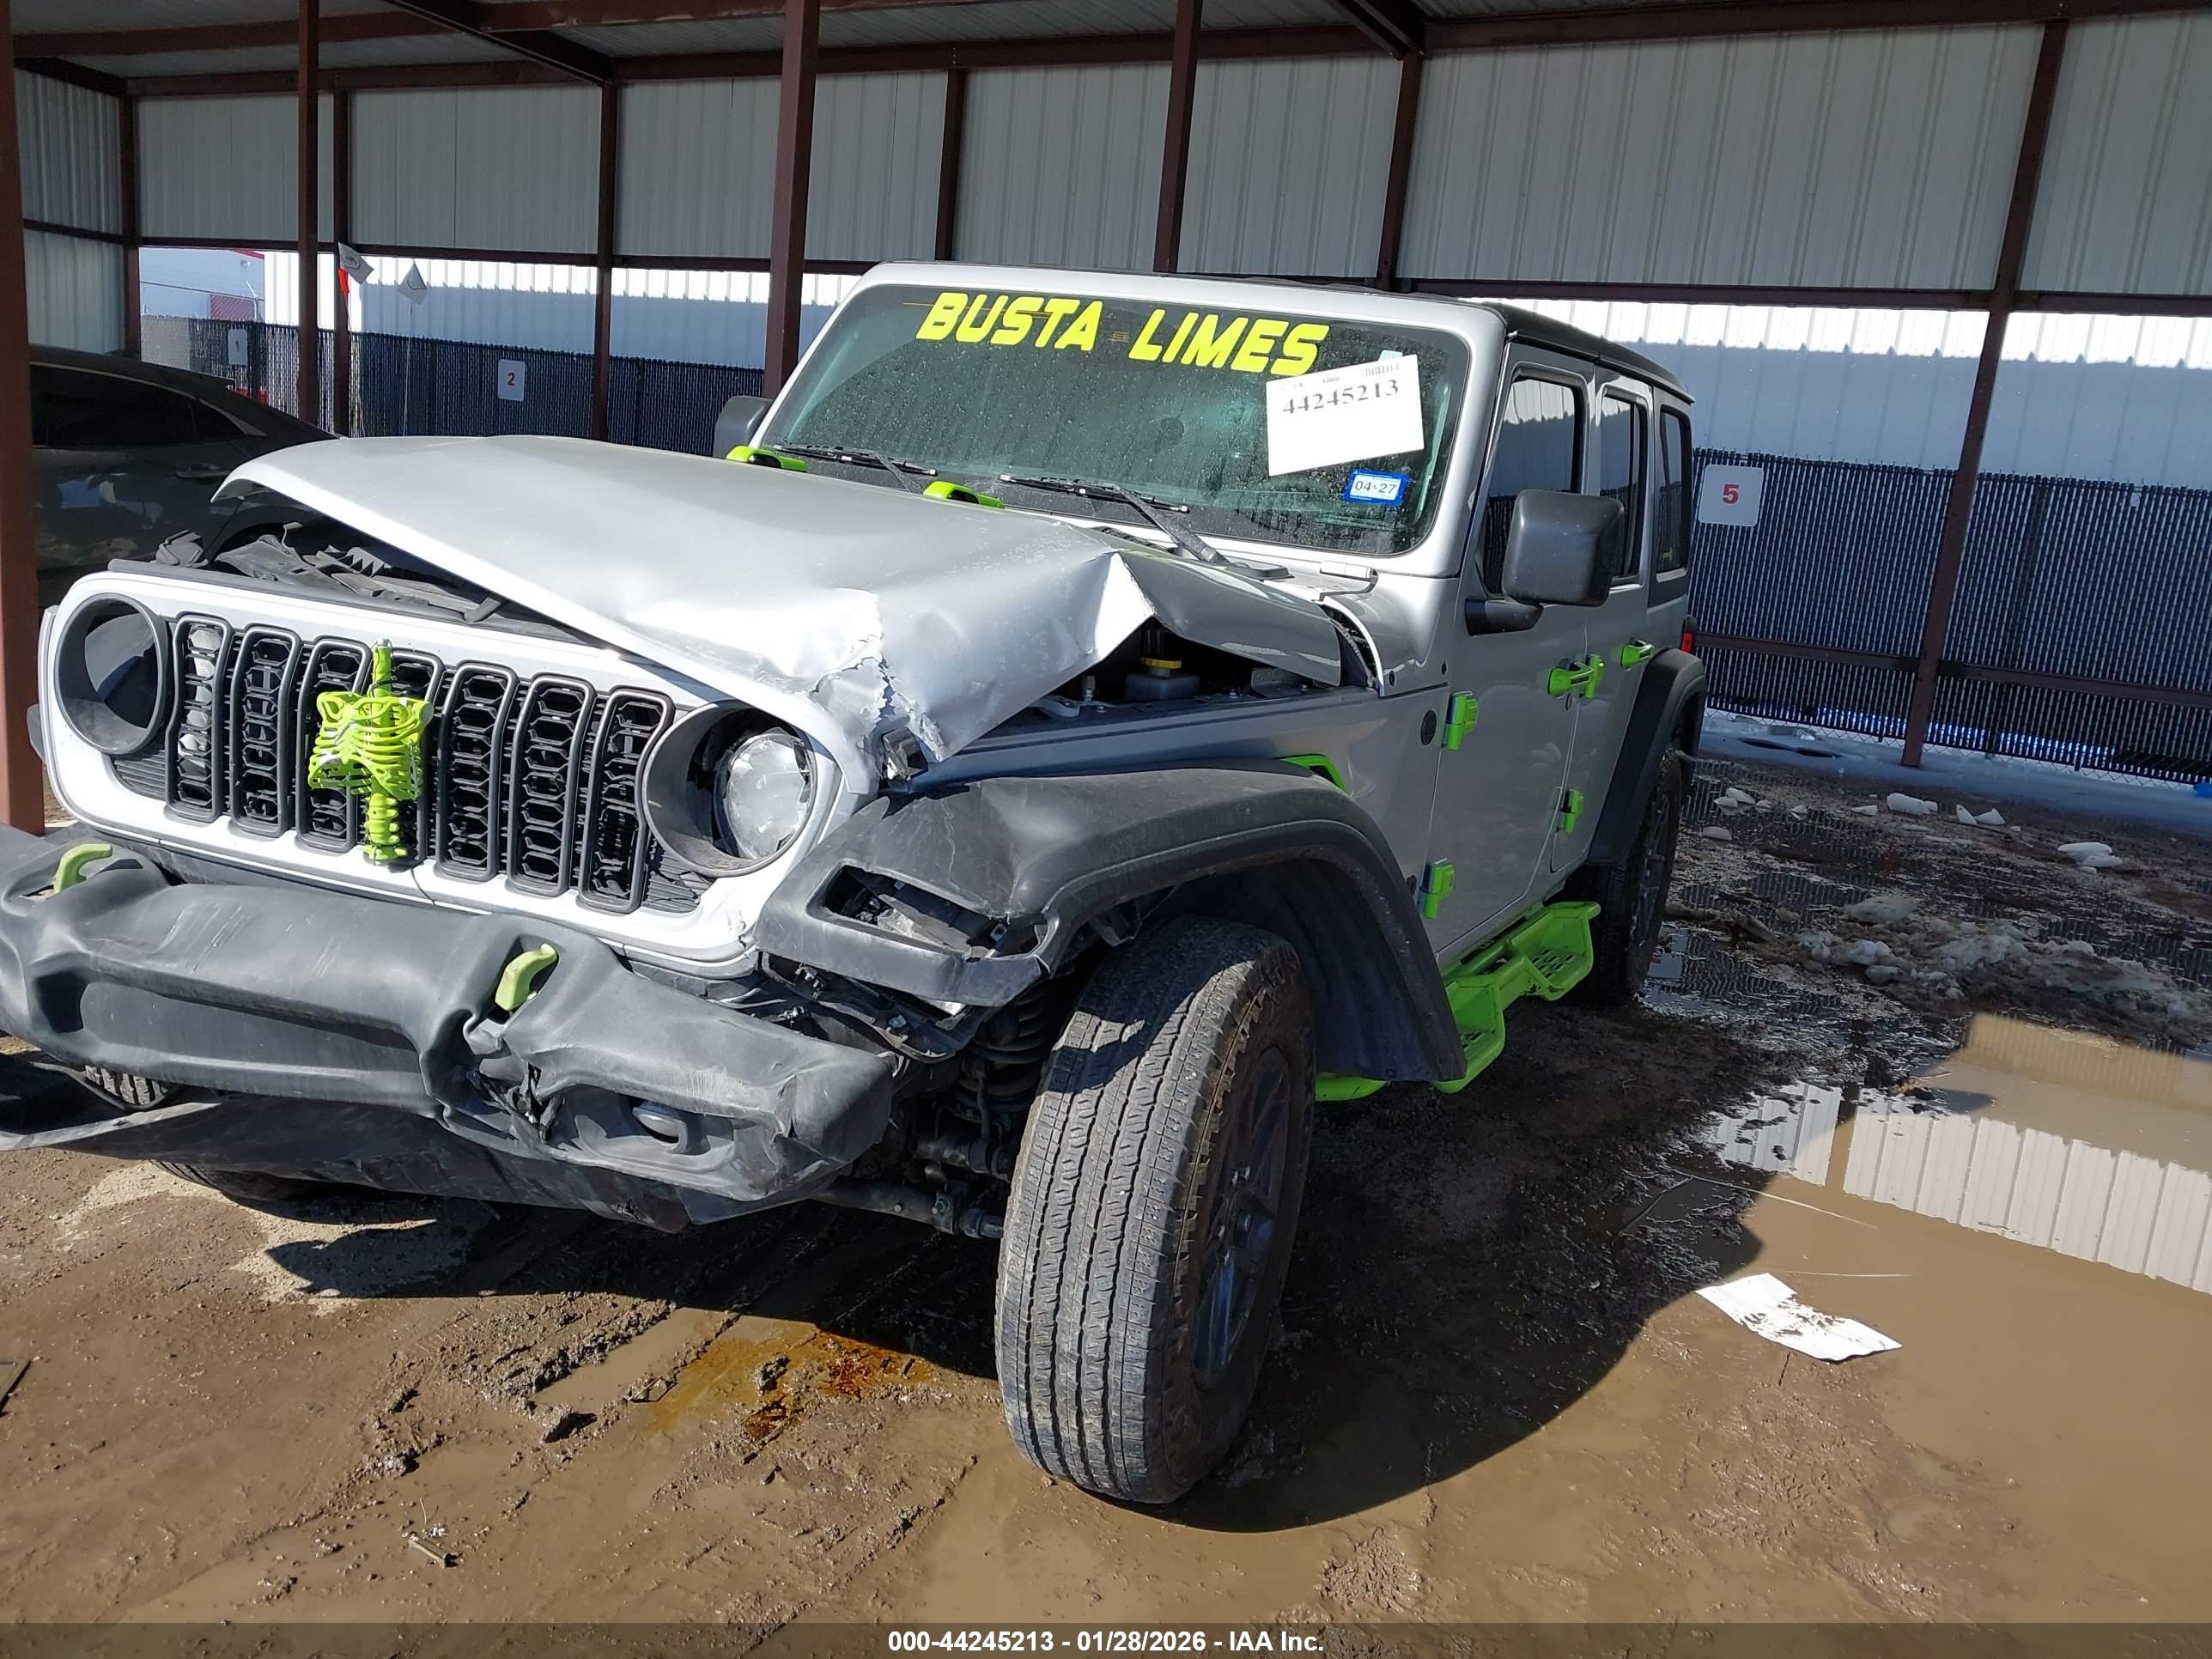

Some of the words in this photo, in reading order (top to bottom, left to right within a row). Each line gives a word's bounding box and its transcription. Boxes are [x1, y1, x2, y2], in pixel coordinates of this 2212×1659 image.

[916, 292, 1103, 351] BUSTA
[1128, 309, 1330, 376] LIMES
[235, 340, 240, 351] 1
[507, 372, 515, 386] 2
[1283, 379, 1399, 414] 44245213
[1723, 483, 1739, 504] 5
